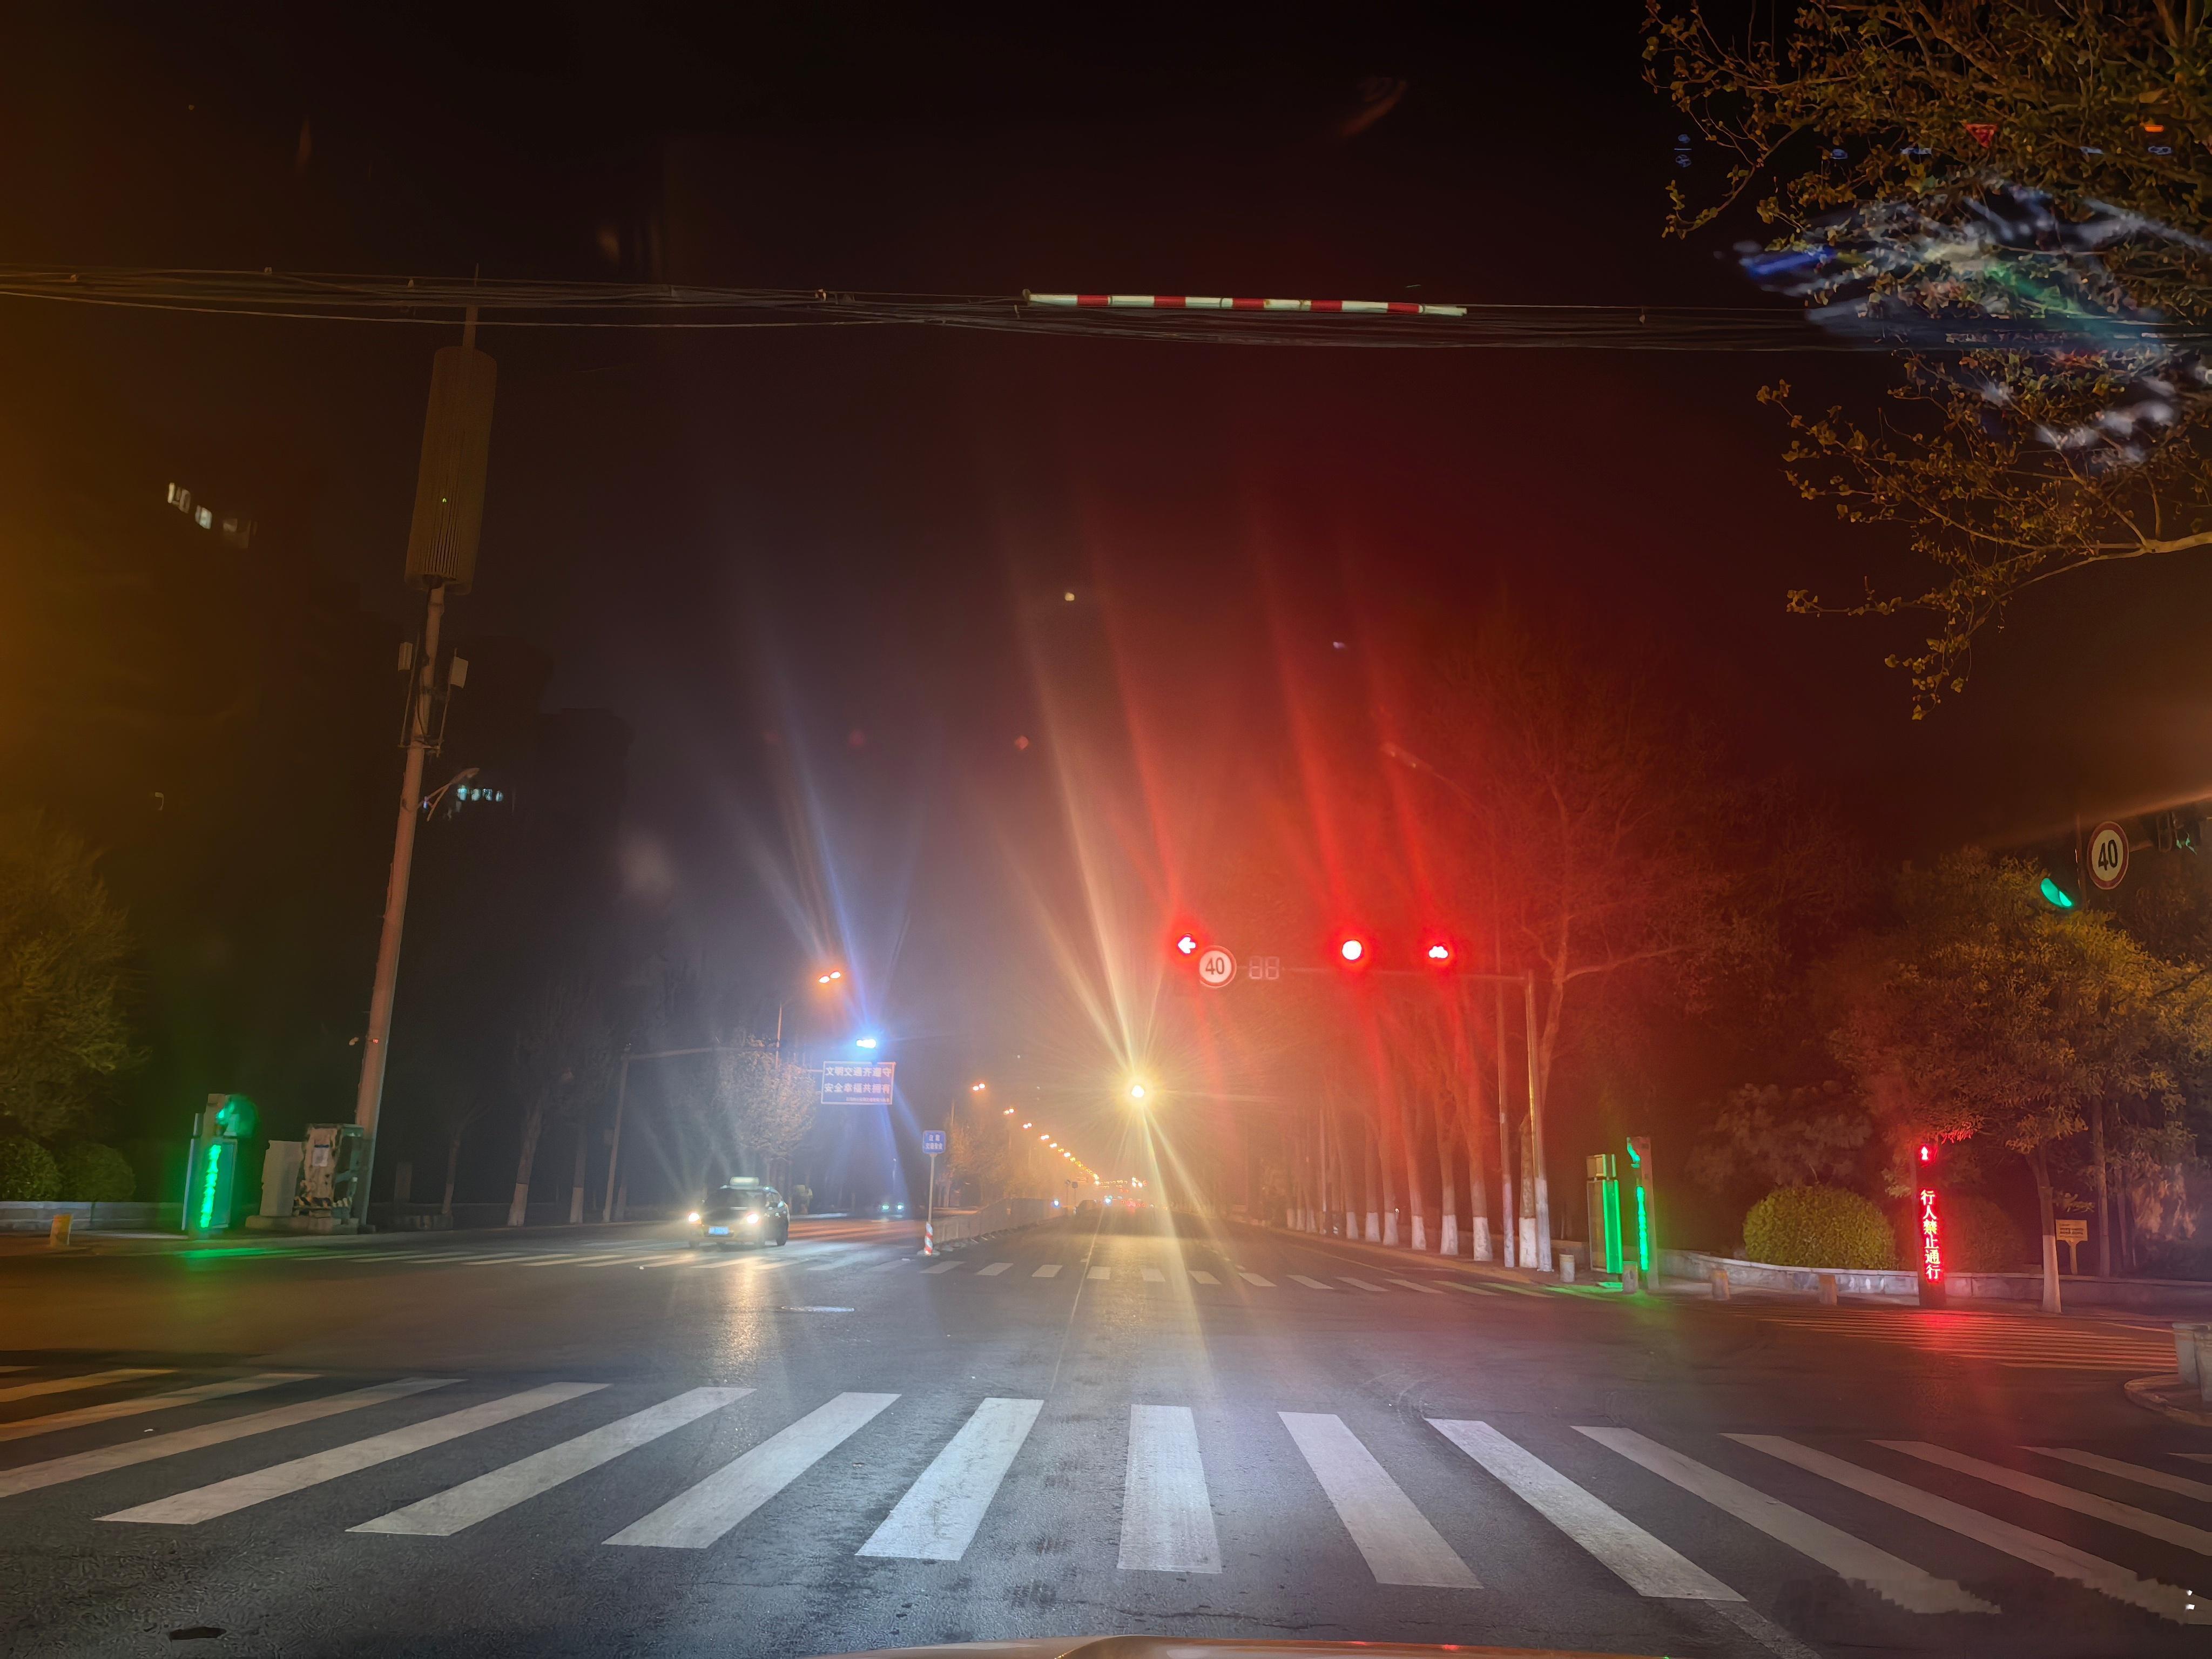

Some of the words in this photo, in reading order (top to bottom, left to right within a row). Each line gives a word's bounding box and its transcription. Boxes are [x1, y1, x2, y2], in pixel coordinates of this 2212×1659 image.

[2098, 839, 2118, 871] 40
[1205, 957, 1224, 975] 40
[1920, 1189, 1941, 1280] 行人禁止通行
